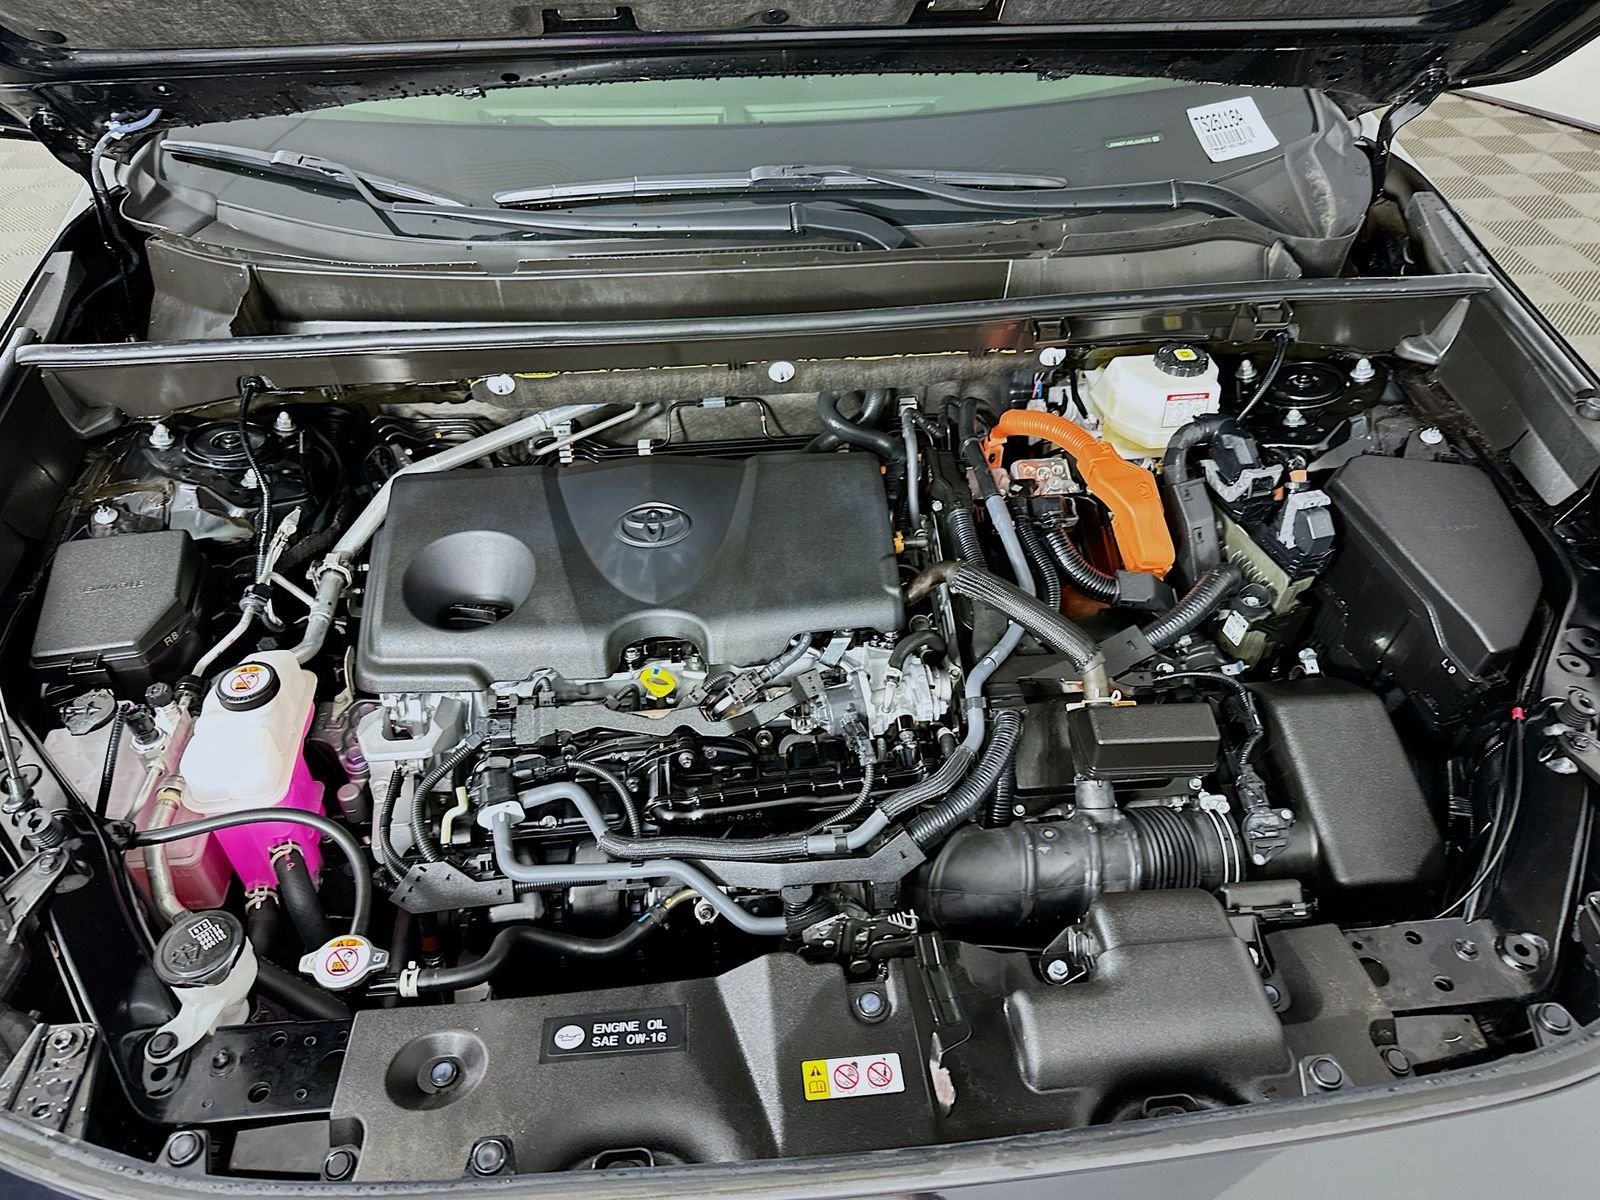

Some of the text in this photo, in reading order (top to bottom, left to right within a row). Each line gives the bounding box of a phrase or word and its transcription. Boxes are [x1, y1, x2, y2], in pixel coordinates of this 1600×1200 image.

[1193, 107, 1246, 135] TS26116A
[164, 631, 179, 646] R8
[592, 1019, 668, 1035] ENGINE OIL
[591, 1031, 667, 1047] SAE 0W-16
